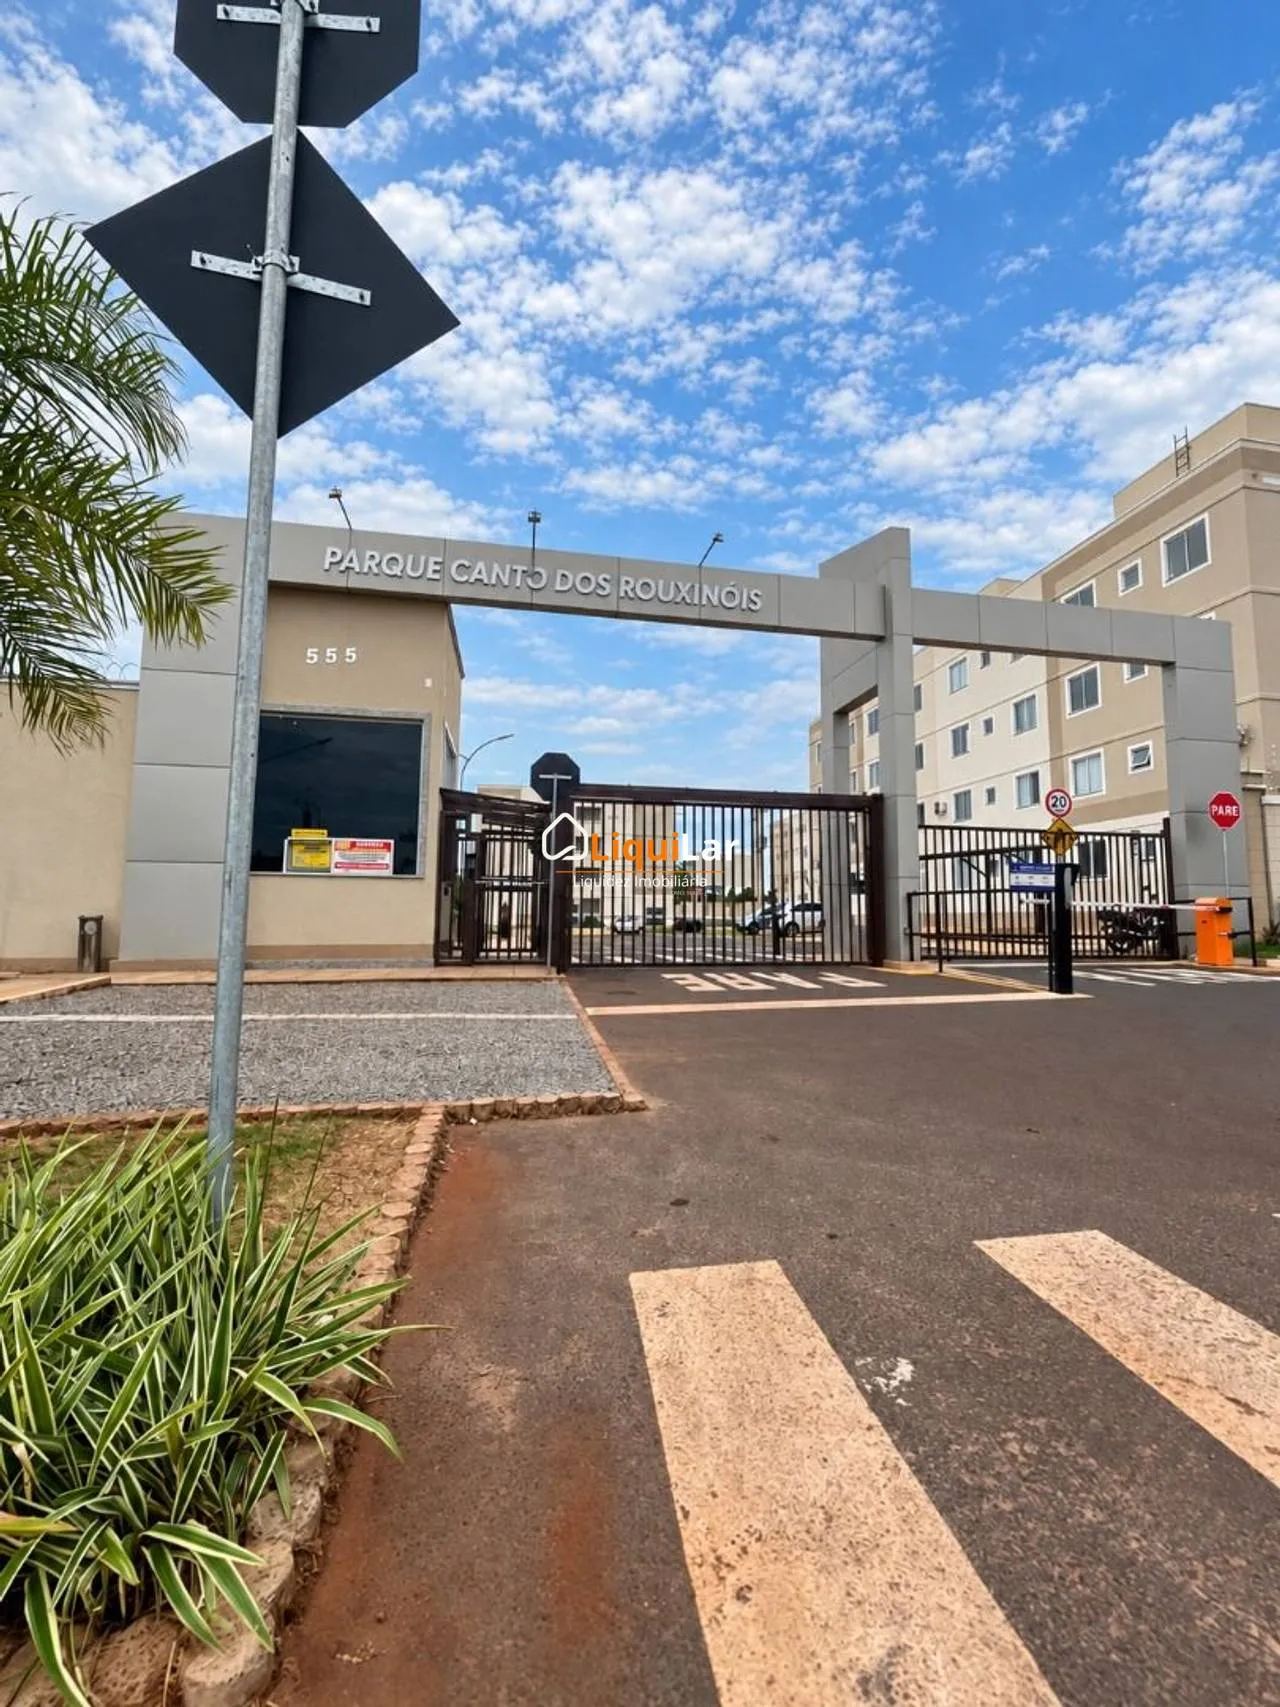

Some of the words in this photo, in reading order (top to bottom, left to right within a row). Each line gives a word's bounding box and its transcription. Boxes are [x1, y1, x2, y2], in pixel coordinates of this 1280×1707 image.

[323, 546, 444, 580] PARQUE
[450, 559, 548, 590] CANTO
[555, 569, 612, 596] DOS
[619, 576, 763, 613] ROUXINÓIS
[1051, 795, 1067, 808] 20
[1211, 804, 1239, 817] PARE
[660, 972, 888, 992] PARE
